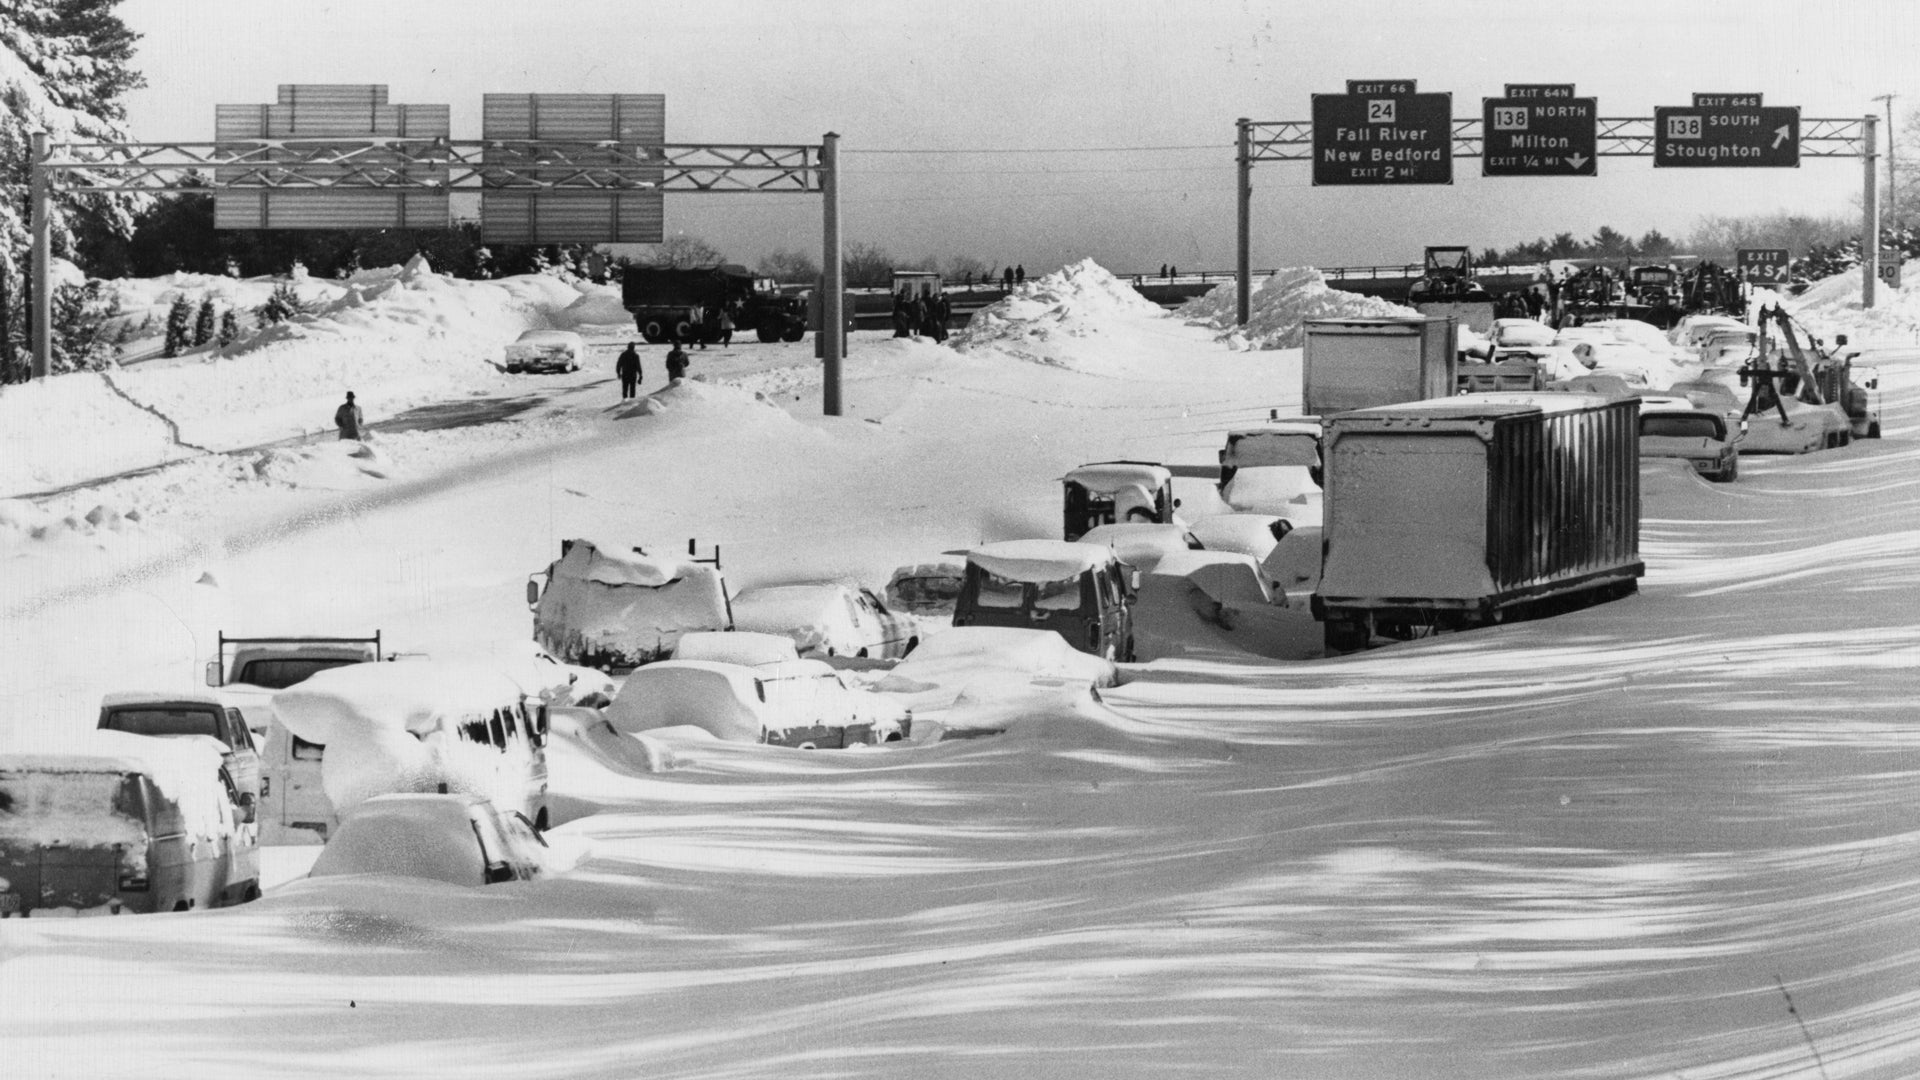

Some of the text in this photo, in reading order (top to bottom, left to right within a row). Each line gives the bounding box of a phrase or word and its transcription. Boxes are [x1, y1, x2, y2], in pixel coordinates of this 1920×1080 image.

[1357, 84, 1406, 94] EXIT 66
[1511, 88, 1569, 98] EXIT 64N
[1698, 97, 1757, 106] EXIT 64S
[1371, 103, 1393, 119] 24
[1535, 106, 1586, 117] NORTH
[1497, 110, 1526, 126] 138
[1709, 115, 1760, 126] SOUTH
[1670, 119, 1699, 135] 138
[1336, 127, 1427, 141] Fall River
[1511, 134, 1569, 148] Milton
[1324, 147, 1441, 162] New Bedford
[1665, 143, 1761, 161] Stoughton
[1490, 156, 1517, 166] EXIT
[1545, 156, 1559, 166] MI
[1351, 166, 1415, 179] EXIT 2 MI
[1747, 251, 1779, 261] EXIT
